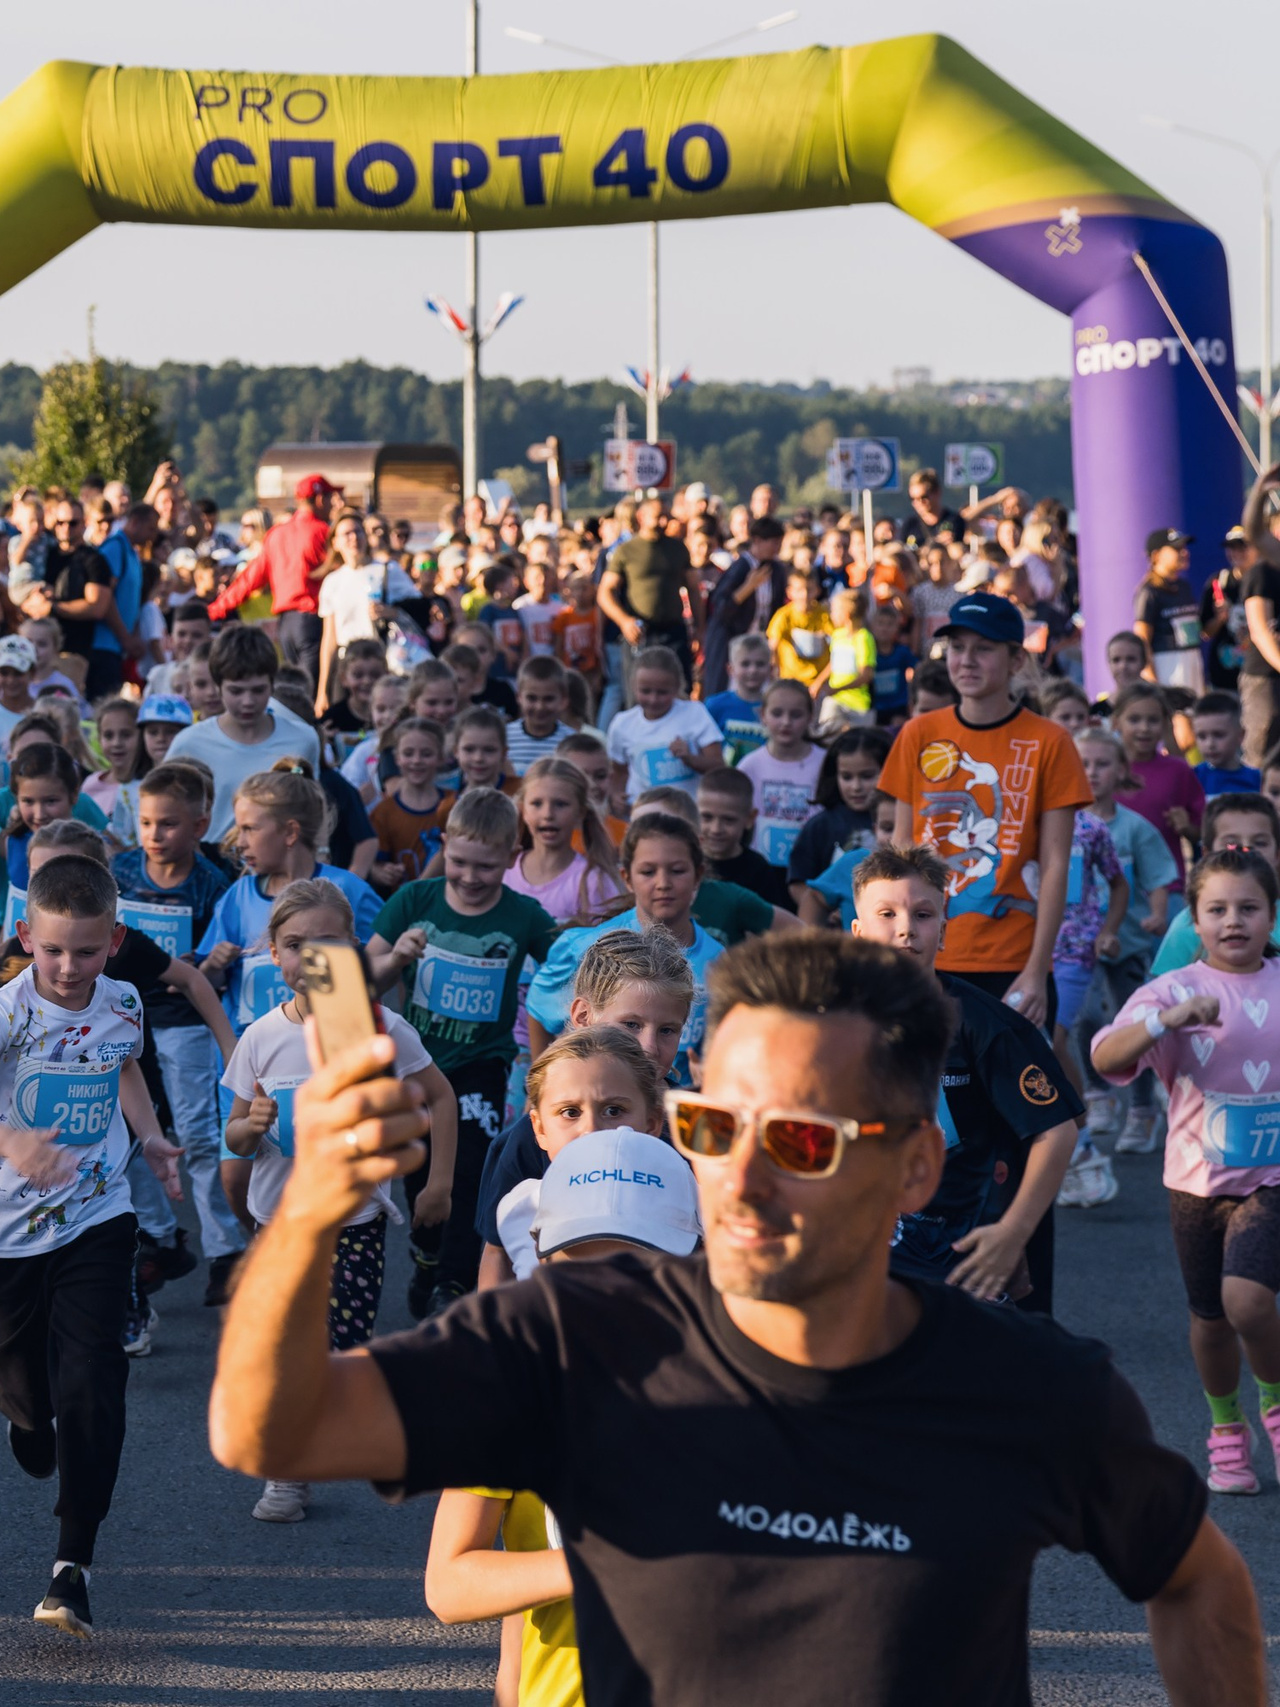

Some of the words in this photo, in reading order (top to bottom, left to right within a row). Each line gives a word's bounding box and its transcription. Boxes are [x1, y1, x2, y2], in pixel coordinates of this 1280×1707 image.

[195, 86, 328, 125] PRO
[193, 133, 563, 209] СПОРТ
[593, 122, 731, 199] 40
[1076, 337, 1182, 376] СПОРТ
[1001, 738, 1040, 856] TUNE
[440, 983, 495, 1015] 5033
[67, 1083, 108, 1099] НИКИТА
[52, 1100, 113, 1135] 2565
[459, 1093, 499, 1138] NYC
[1249, 1127, 1280, 1158] 77
[569, 1169, 665, 1188] KICHLER
